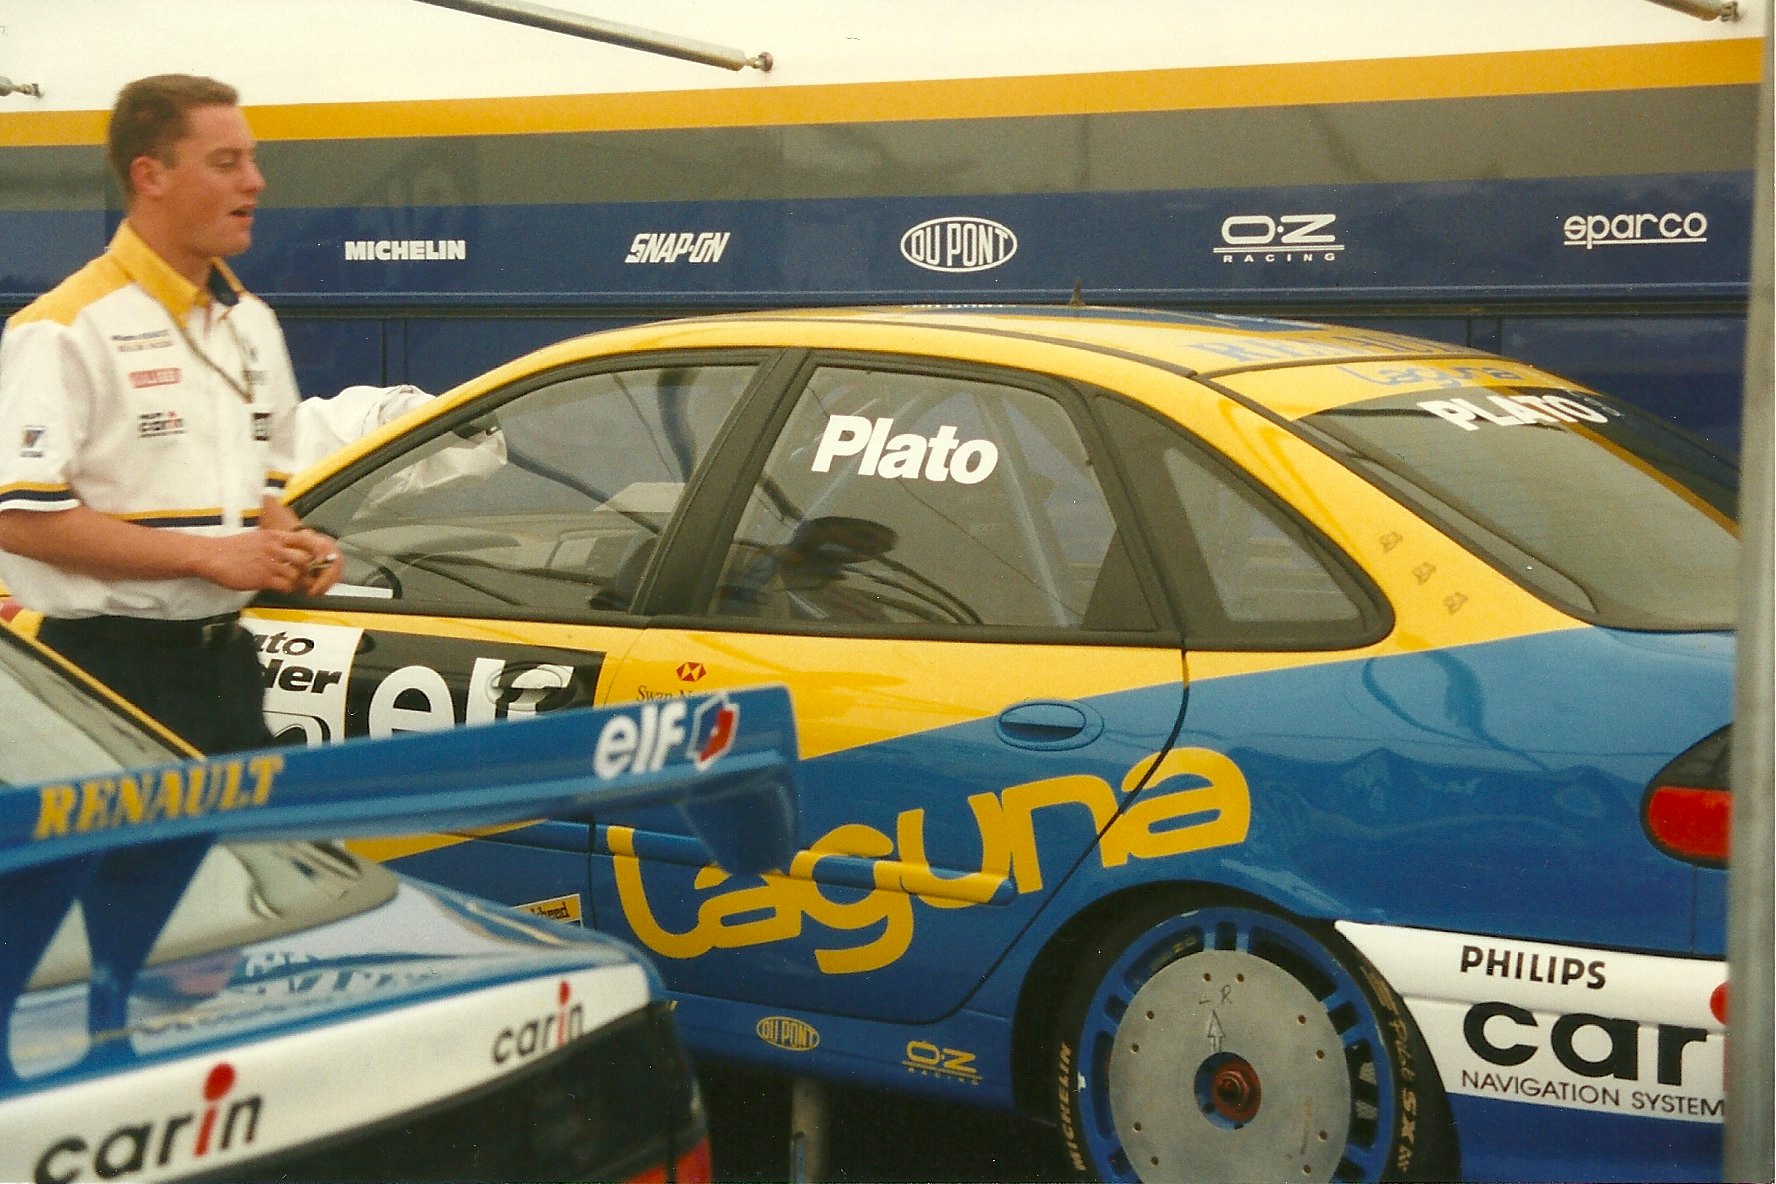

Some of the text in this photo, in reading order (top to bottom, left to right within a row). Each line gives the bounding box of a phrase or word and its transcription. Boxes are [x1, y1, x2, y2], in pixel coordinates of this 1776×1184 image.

[345, 239, 467, 261] MICHELIN
[910, 223, 1009, 267] DU PONT
[1223, 253, 1336, 263] RACING
[1563, 211, 1708, 250] sparco
[1416, 395, 1609, 431] PLATO
[811, 413, 999, 485] Plato
[594, 700, 686, 780] elf
[33, 755, 284, 840] RENAULT
[607, 747, 1251, 974] Laguna
[1460, 945, 1607, 990] PHILIPS
[491, 980, 586, 1065] carin
[1058, 1040, 1087, 1171] MICHELIN
[1462, 1068, 1621, 1107] NAVIGATION
[33, 1062, 264, 1184] carin
